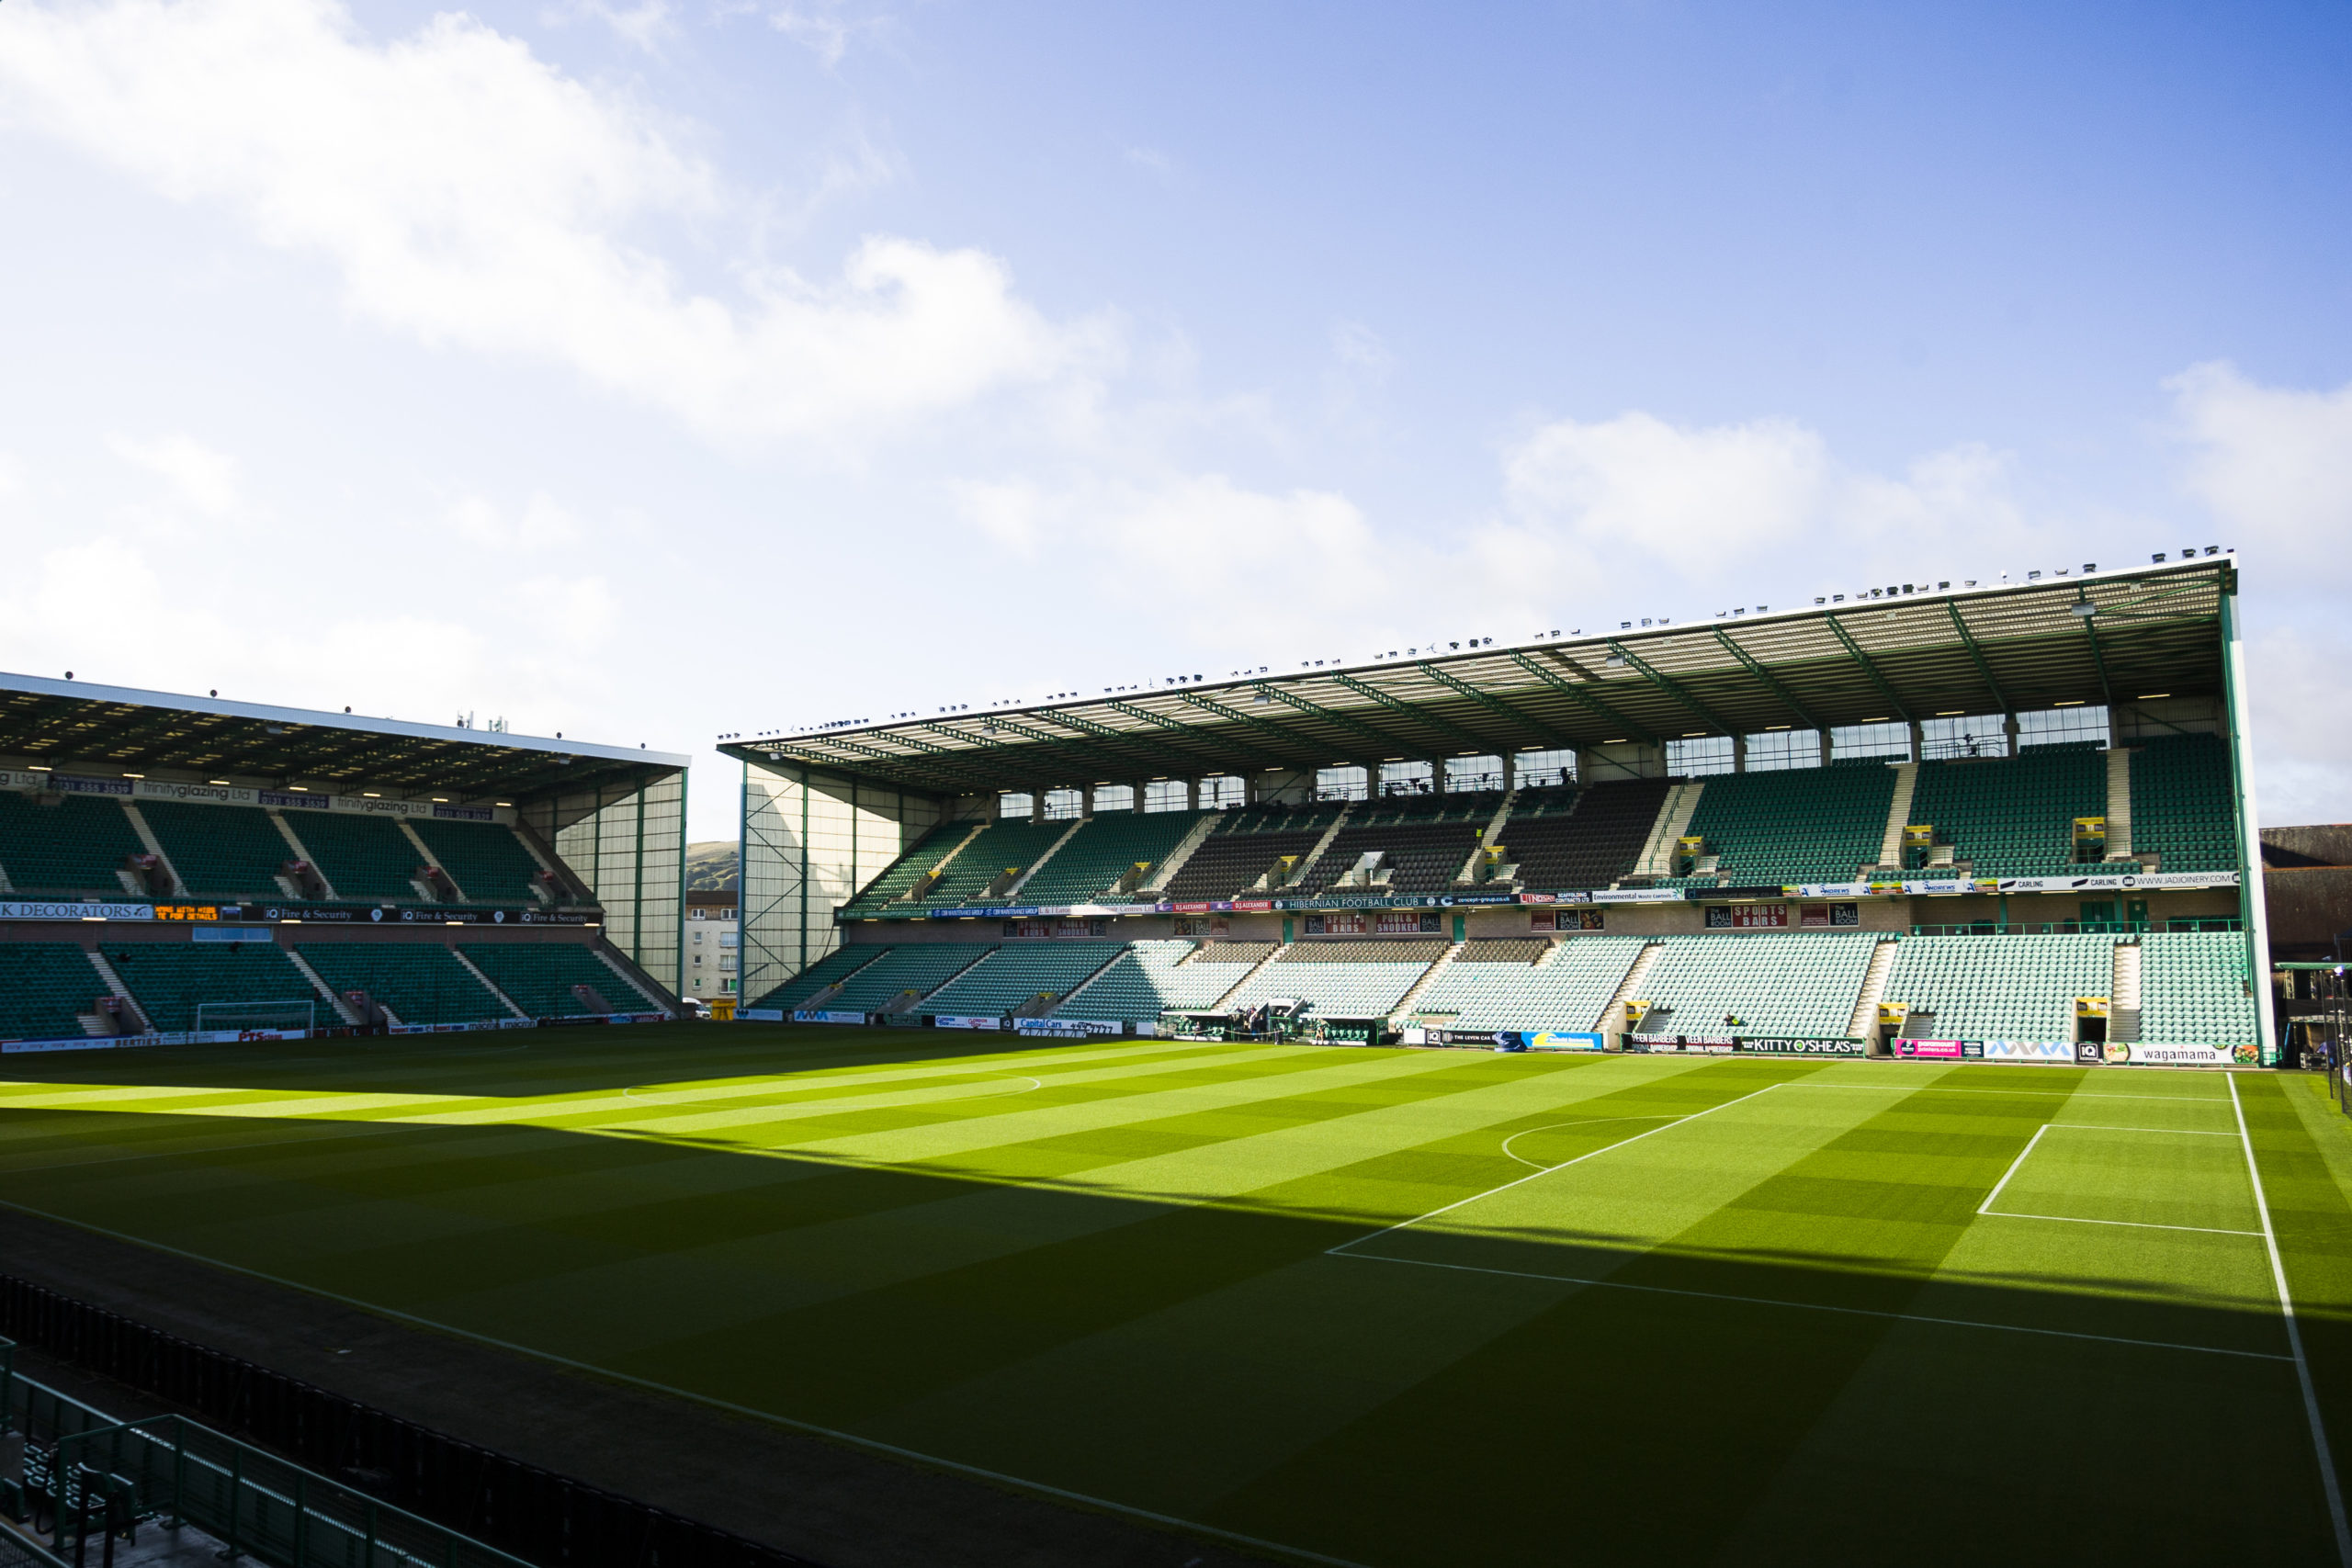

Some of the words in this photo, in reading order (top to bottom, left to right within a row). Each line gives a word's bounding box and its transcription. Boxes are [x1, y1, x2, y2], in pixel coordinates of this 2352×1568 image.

[80, 783, 99, 792] 555
[103, 784, 129, 794] 3539
[144, 783, 228, 800] trinityglazing
[232, 789, 250, 800] Ltd
[285, 798, 301, 807] 555
[306, 799, 325, 808] 3539
[338, 797, 408, 814] trinityglazing
[411, 804, 426, 814] Ltd
[2136, 875, 2230, 886] WWW.JADJOINERY.COM
[1457, 895, 1510, 904] concept-group.co.uk
[1594, 893, 1637, 902] Environmental
[1290, 899, 1339, 909] HIBERNIAN
[1341, 897, 1390, 908] FOOTBALL
[1393, 897, 1419, 906] CLUB
[2, 905, 14, 916] K
[20, 904, 131, 917] DECORATORS
[281, 908, 300, 919] Fire
[303, 909, 311, 919] &
[312, 908, 352, 920] Security
[1735, 905, 1785, 916] SPORTS
[1835, 910, 1858, 919] BALL
[415, 911, 432, 919] Fire
[435, 911, 441, 920] &
[444, 911, 478, 922] Security
[533, 913, 547, 921] Fire
[549, 913, 556, 921] &
[558, 914, 588, 923] Security
[1327, 914, 1364, 924] SPORTS
[1382, 914, 1405, 922] POOL
[1406, 914, 1412, 922] &
[1743, 916, 1778, 926] BARS
[1332, 923, 1359, 931] BARS
[1376, 923, 1418, 931] SNOOKER
[1020, 1019, 1045, 1028] Capital
[1046, 1020, 1062, 1028] Cars
[115, 1038, 161, 1047] BERTIE'S
[1648, 1034, 1678, 1043] BARBERS
[1703, 1036, 1734, 1044] BARBERS
[1754, 1039, 1792, 1051] KITTY
[1793, 1040, 1850, 1053] O'SHEA'S
[2143, 1050, 2216, 1061] wagamama
